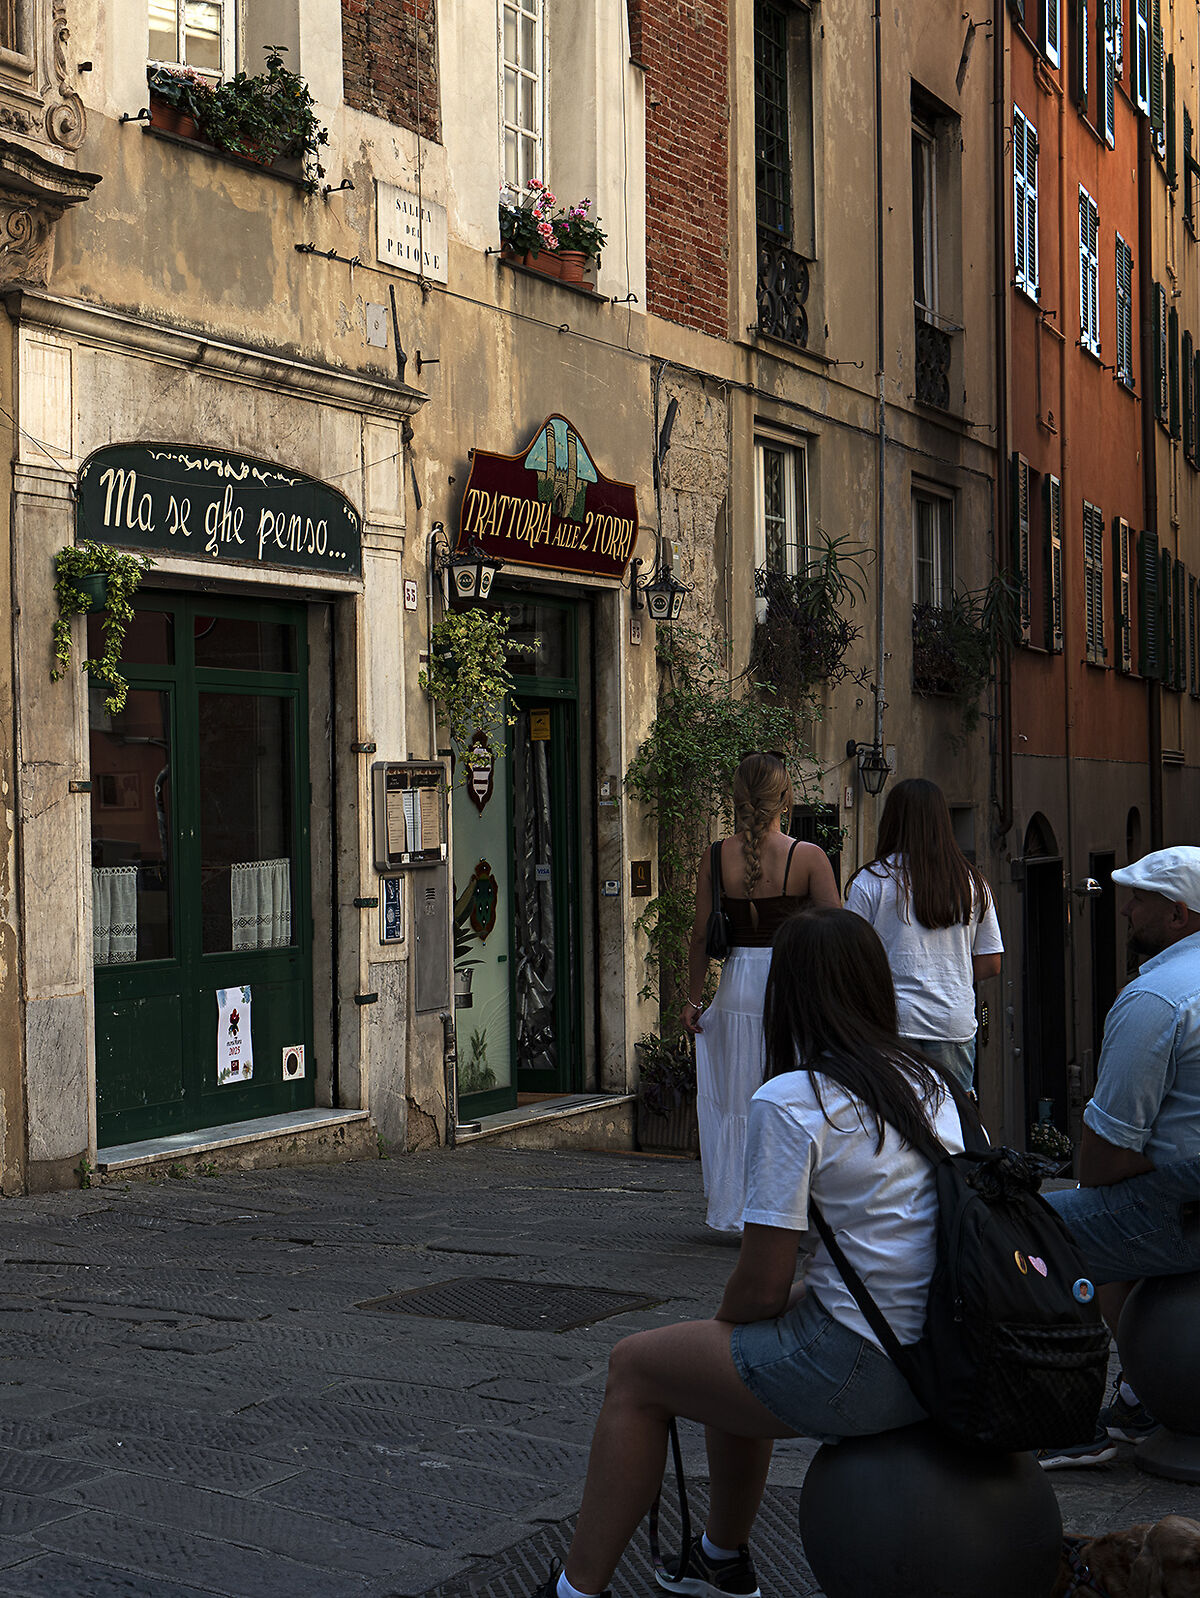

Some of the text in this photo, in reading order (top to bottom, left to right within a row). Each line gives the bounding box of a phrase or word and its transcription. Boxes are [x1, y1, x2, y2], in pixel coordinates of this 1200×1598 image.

[395, 198, 432, 223] SALITA
[386, 238, 440, 270] PRIONE
[100, 468, 347, 560] Ma se ghe penso...
[464, 488, 635, 563] TRATTORIA ALLE 2 TORRI
